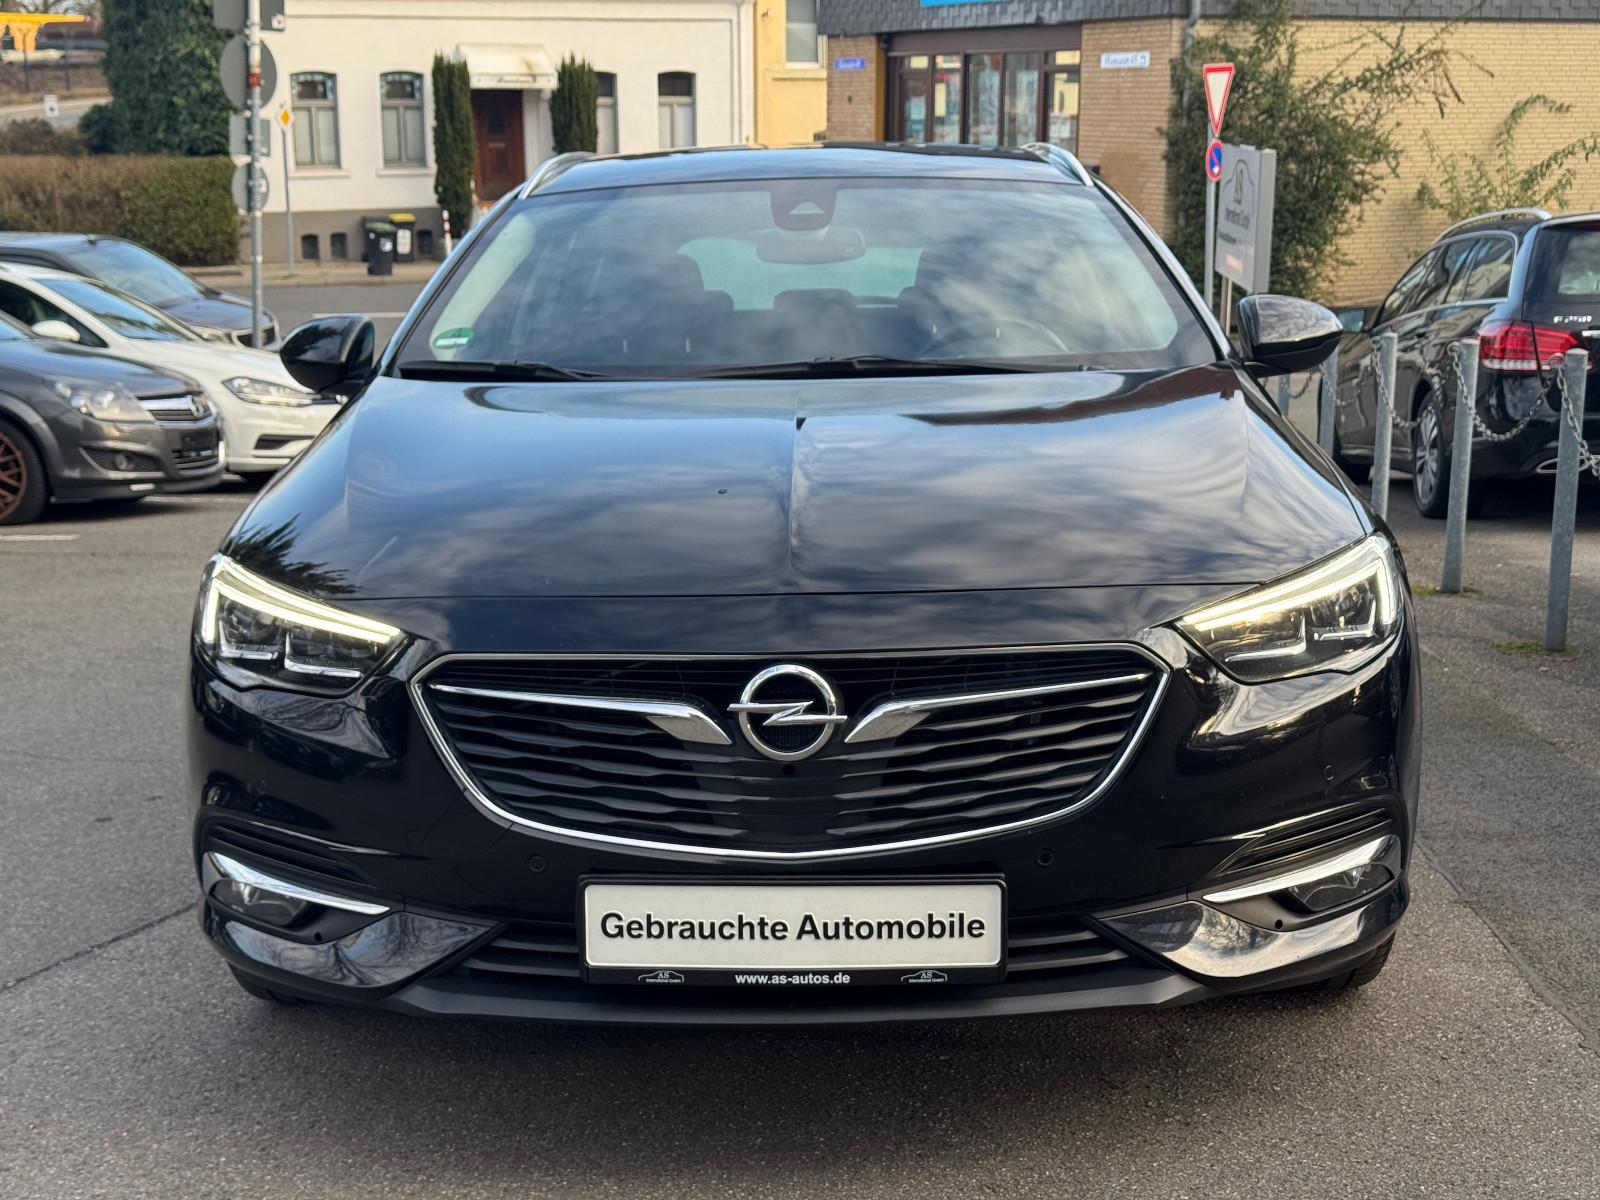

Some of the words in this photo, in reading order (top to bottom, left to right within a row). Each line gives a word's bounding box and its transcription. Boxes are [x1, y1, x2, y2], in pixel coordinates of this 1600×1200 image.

[600, 911, 789, 941] Gebrauchte
[796, 912, 986, 941] Automobile
[657, 971, 670, 979] AS
[734, 971, 851, 985] www.as-autos.de
[920, 971, 933, 979] AS
